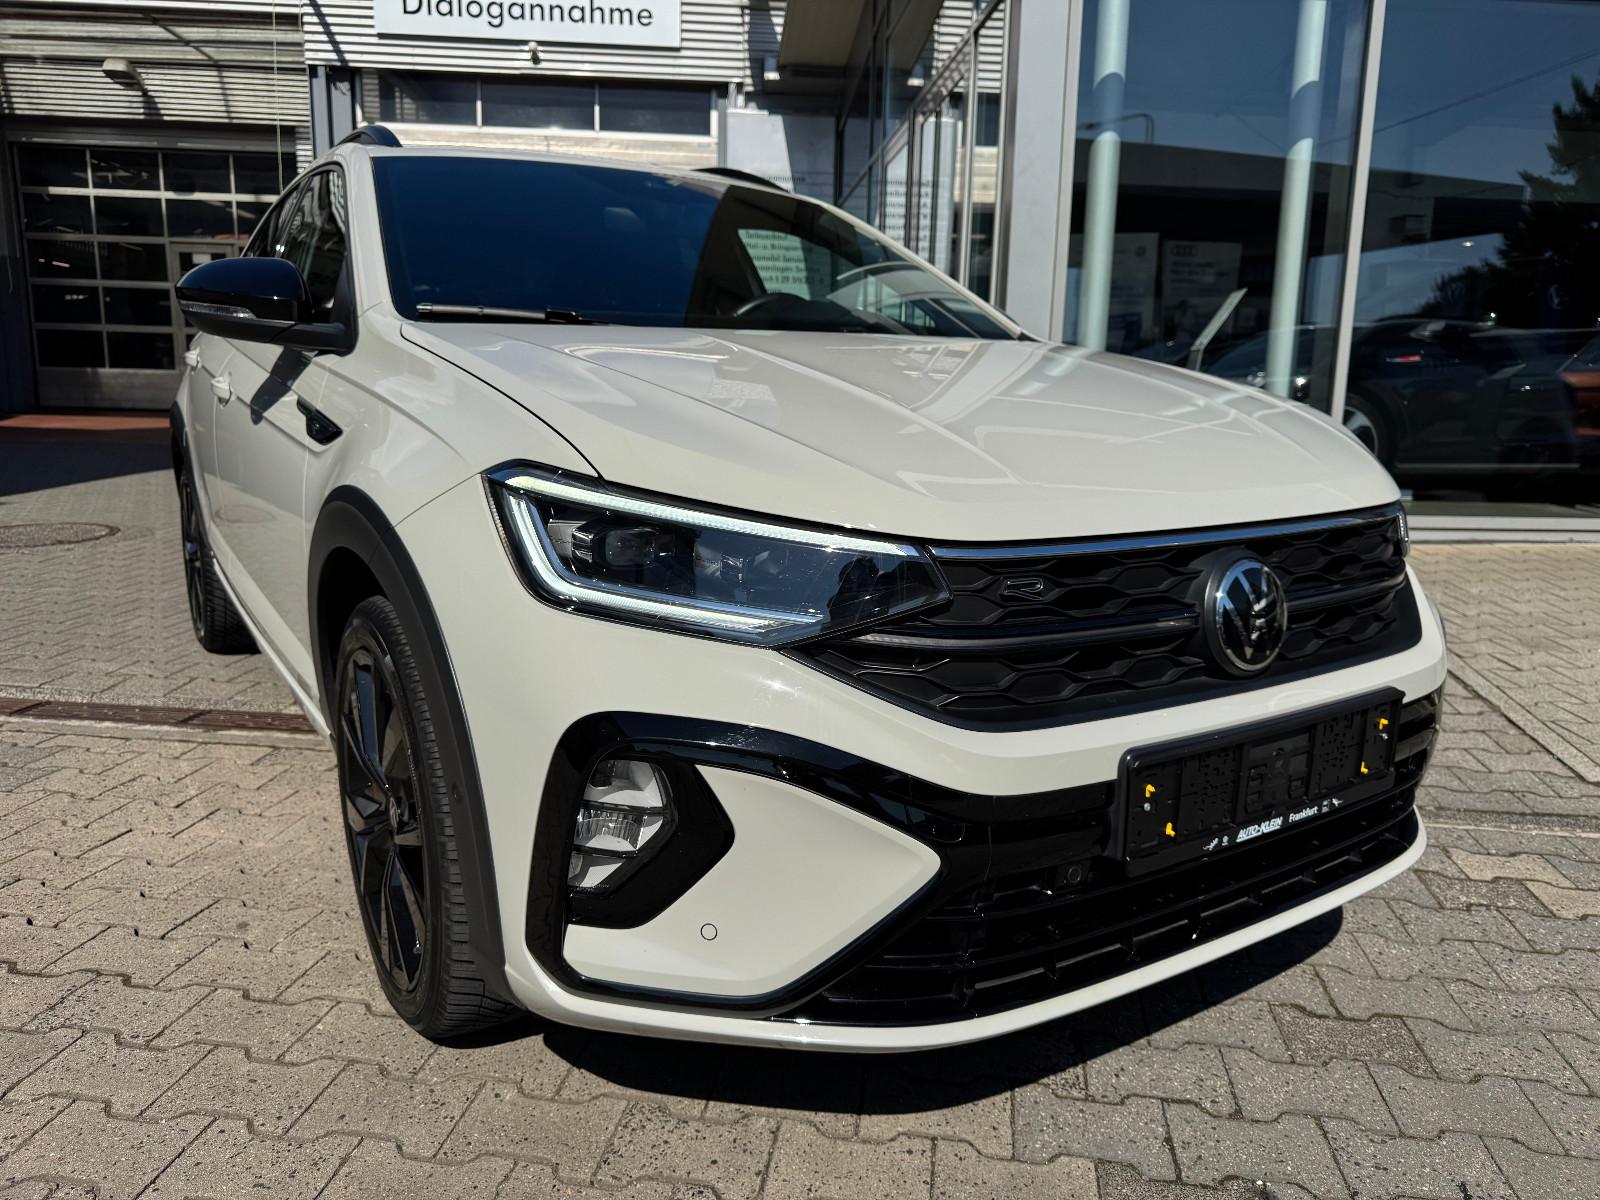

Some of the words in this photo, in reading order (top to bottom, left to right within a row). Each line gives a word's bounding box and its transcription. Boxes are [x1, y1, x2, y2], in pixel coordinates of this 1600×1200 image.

[402, 0, 653, 27] Dialogannahme
[1236, 816, 1283, 842] AUTO-KLEIN
[1289, 805, 1319, 823] Frankfurt
